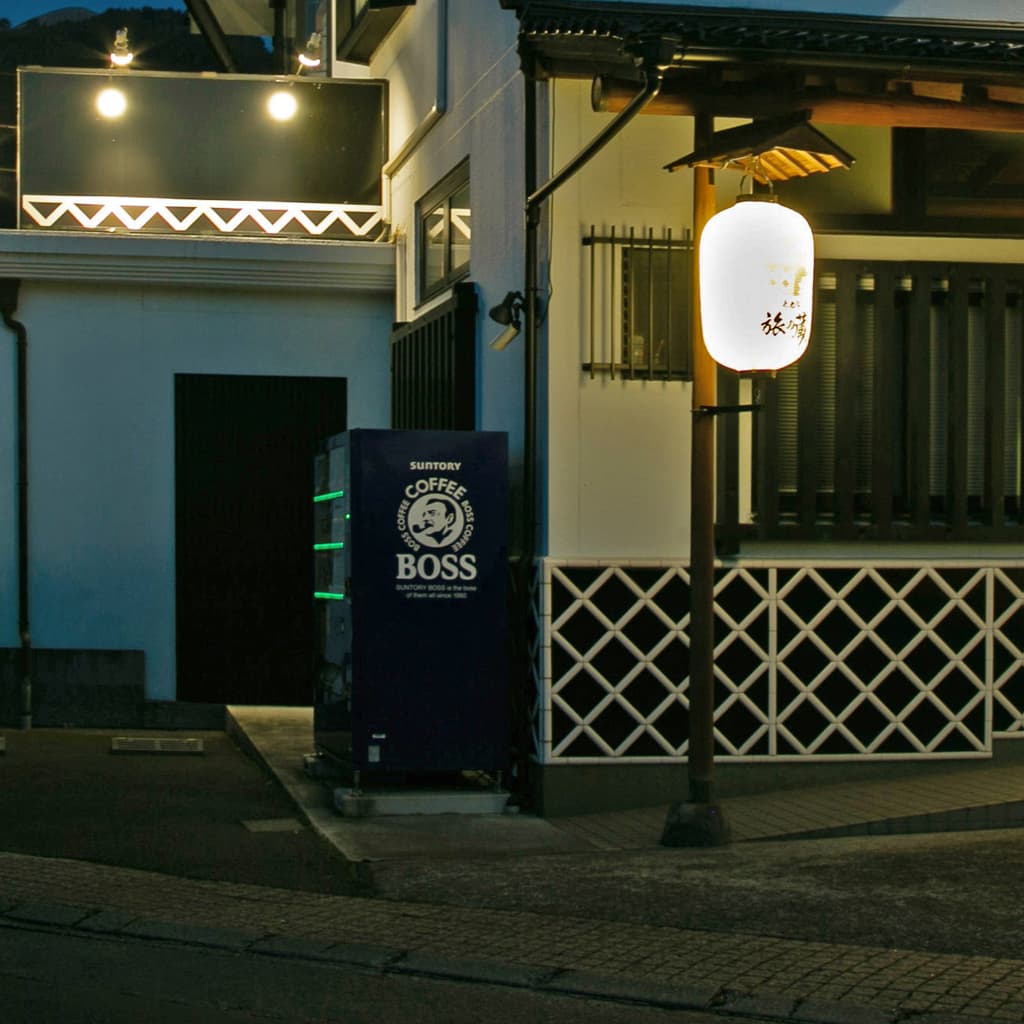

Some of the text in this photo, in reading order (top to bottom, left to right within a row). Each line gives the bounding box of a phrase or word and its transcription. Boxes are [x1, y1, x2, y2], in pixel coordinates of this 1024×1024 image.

[405, 477, 468, 500] COFFEE
[460, 500, 475, 523] BOSS
[395, 554, 477, 580] BOSS
